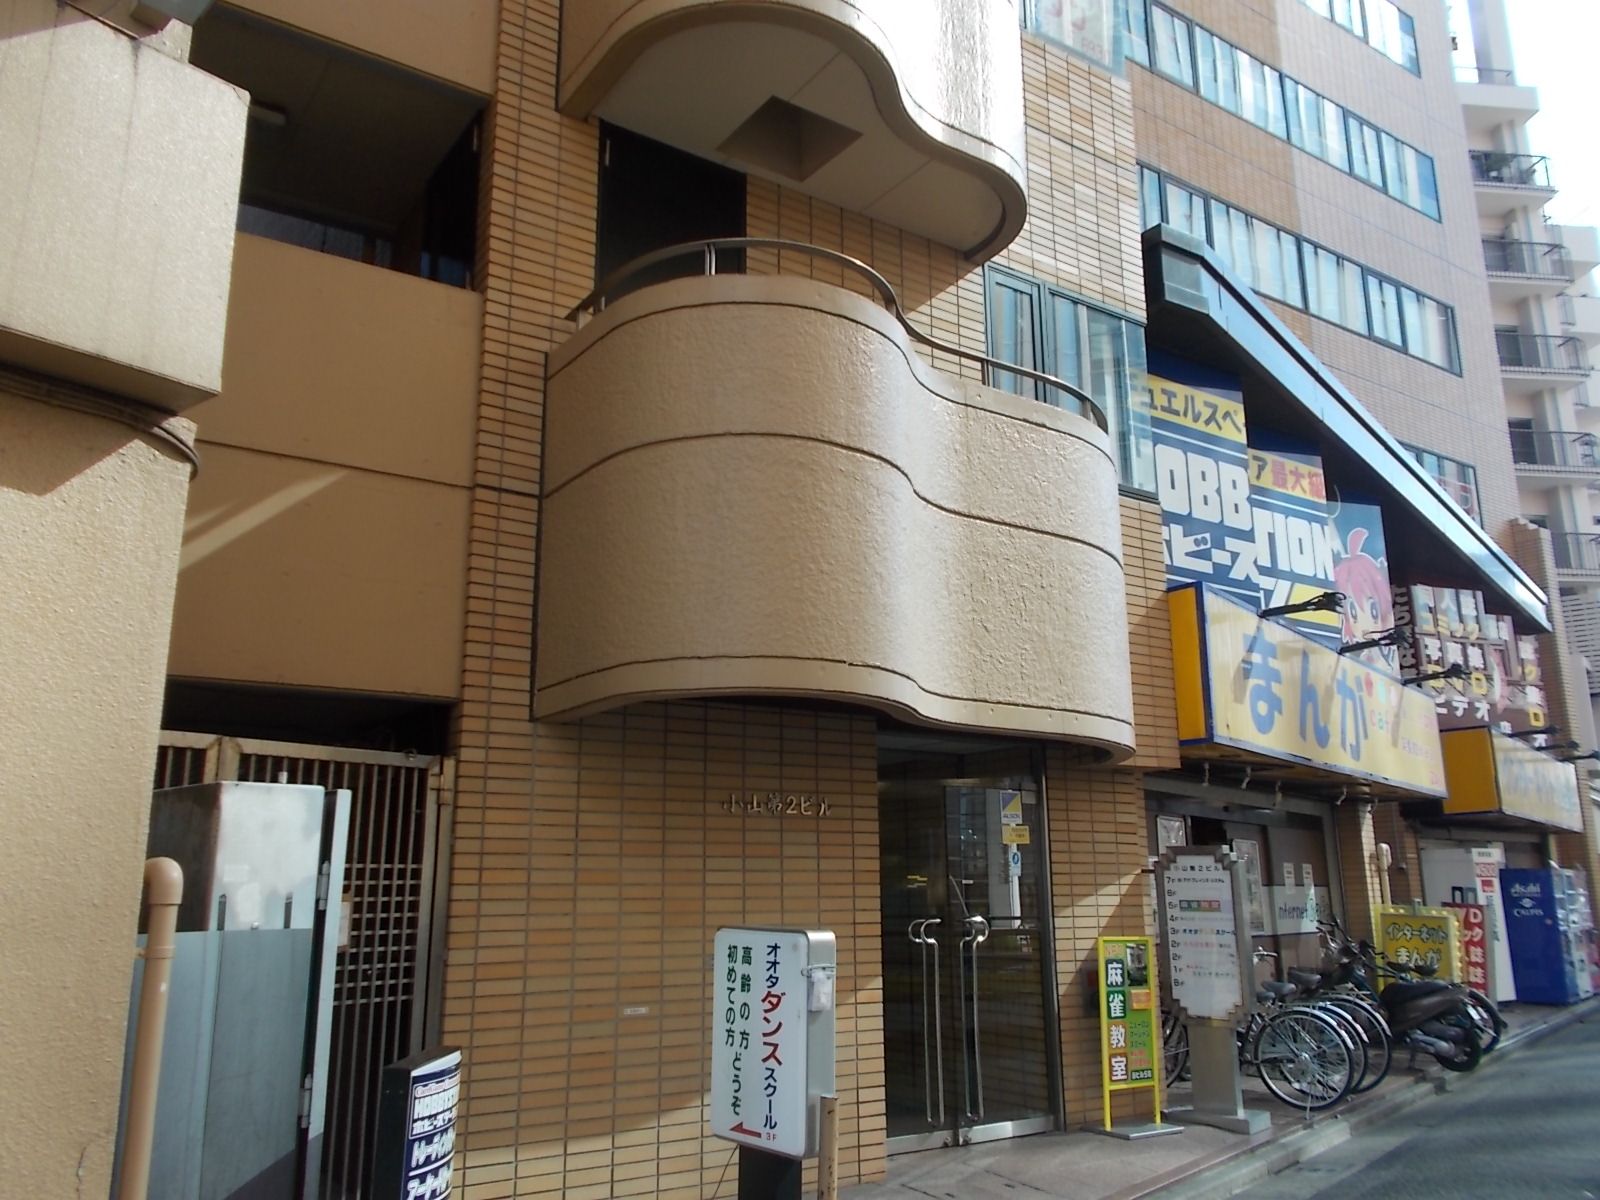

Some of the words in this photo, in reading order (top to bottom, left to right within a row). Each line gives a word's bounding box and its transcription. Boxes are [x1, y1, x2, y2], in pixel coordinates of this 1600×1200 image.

[1134, 384, 1245, 434] ュエルスペ
[1241, 627, 1368, 763] まんが
[722, 791, 832, 817] 小山第2ビル
[725, 944, 738, 1047] 初めての方
[739, 946, 752, 1050] 高齢の方
[761, 942, 786, 1130] オオタダンススクール
[1107, 962, 1128, 1081] 麻雀教室
[731, 1051, 742, 1116] どうぞ
[766, 1132, 777, 1142] 3F
